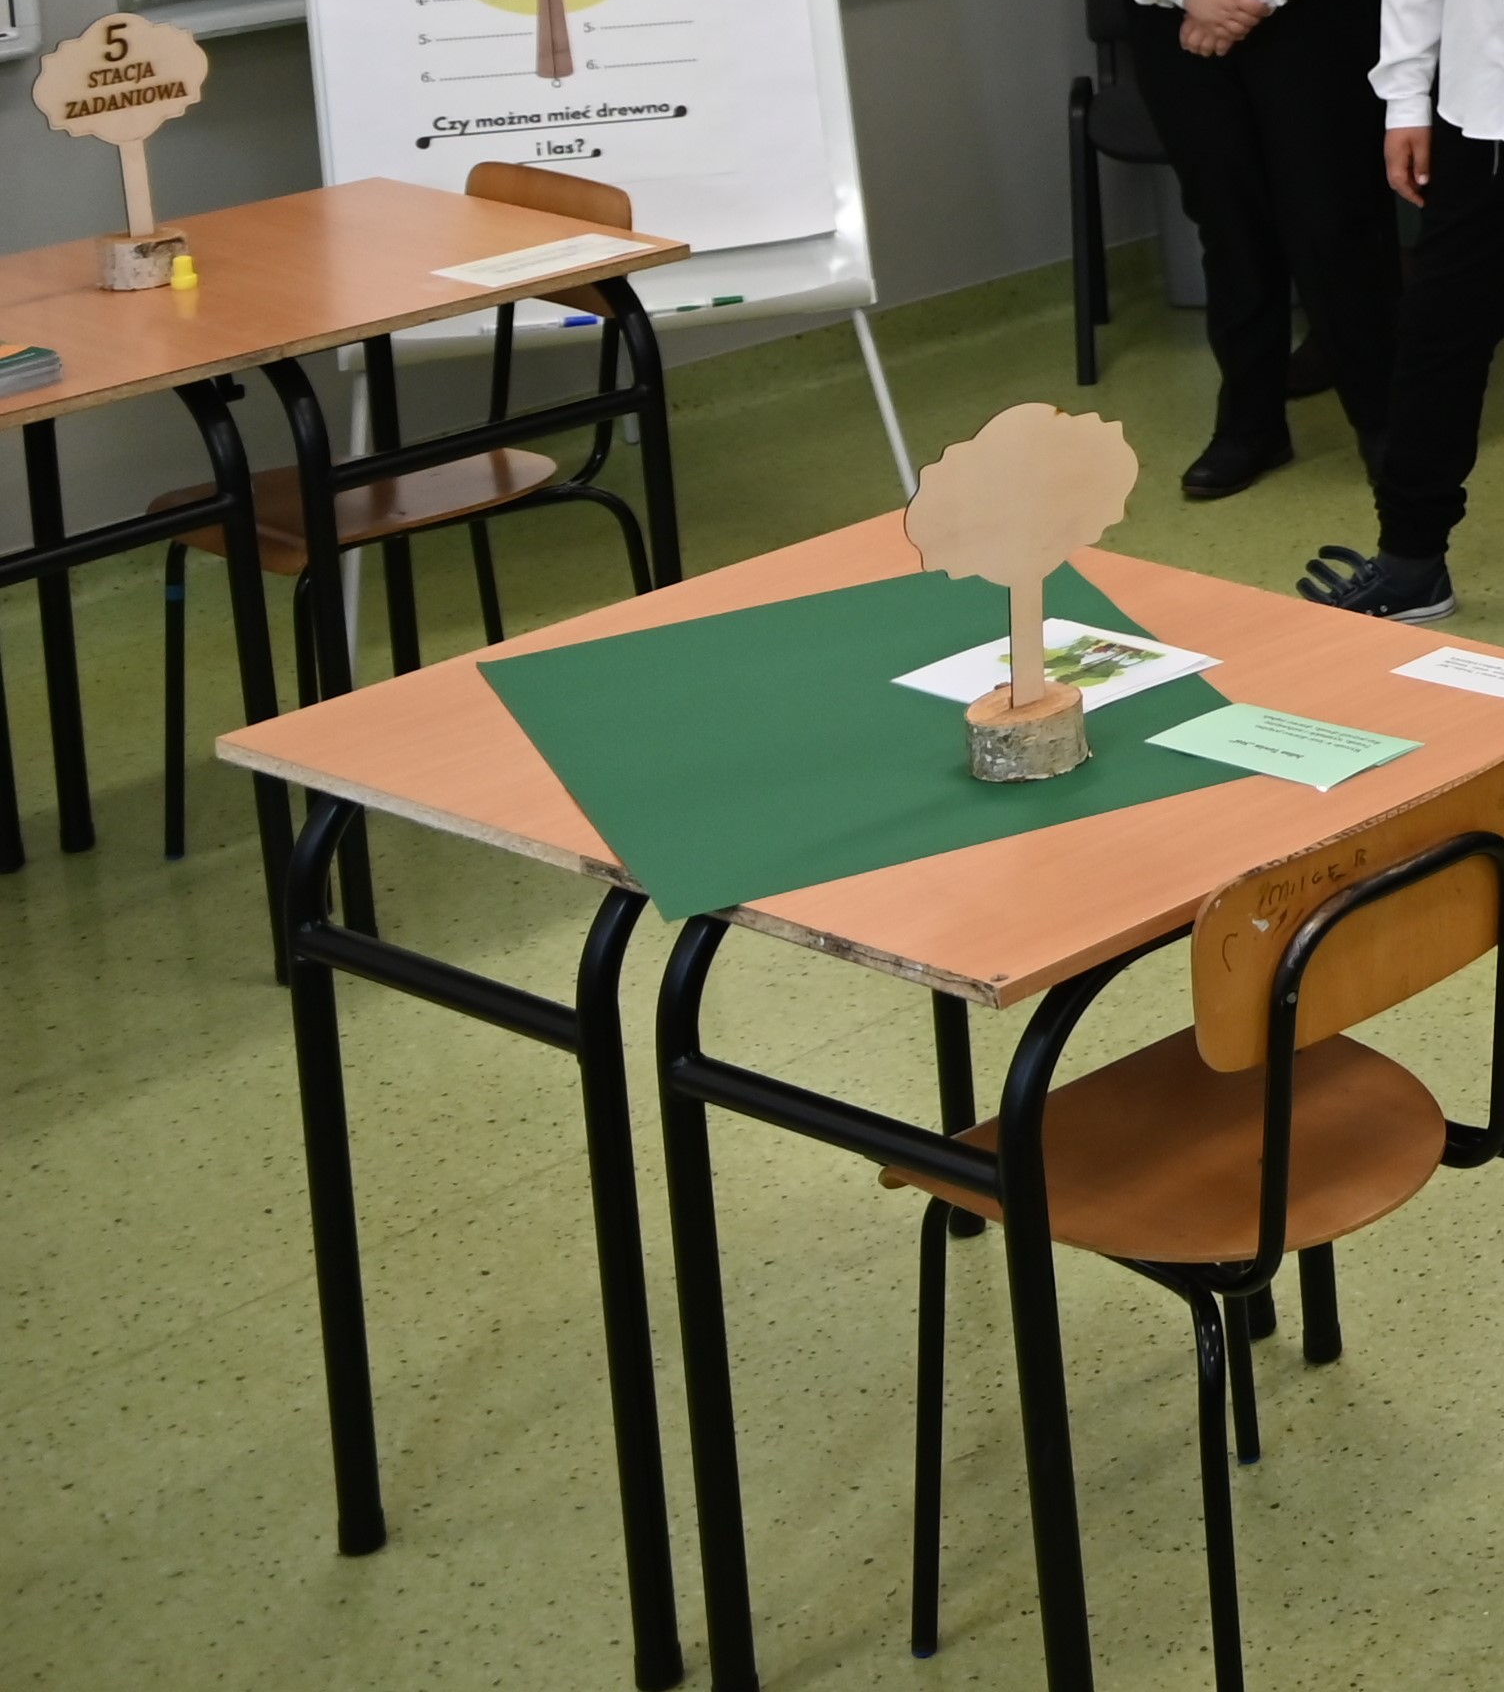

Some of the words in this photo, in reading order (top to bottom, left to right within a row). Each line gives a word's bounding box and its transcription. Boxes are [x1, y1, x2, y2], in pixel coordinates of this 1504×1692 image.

[104, 23, 128, 62] 5
[88, 61, 156, 89] STACJA
[65, 81, 187, 120] ZADANIOWA
[432, 116, 470, 135] Czy
[476, 111, 541, 128] można
[547, 105, 591, 122] mieć
[596, 102, 670, 119] drewno
[547, 138, 585, 156] las?
